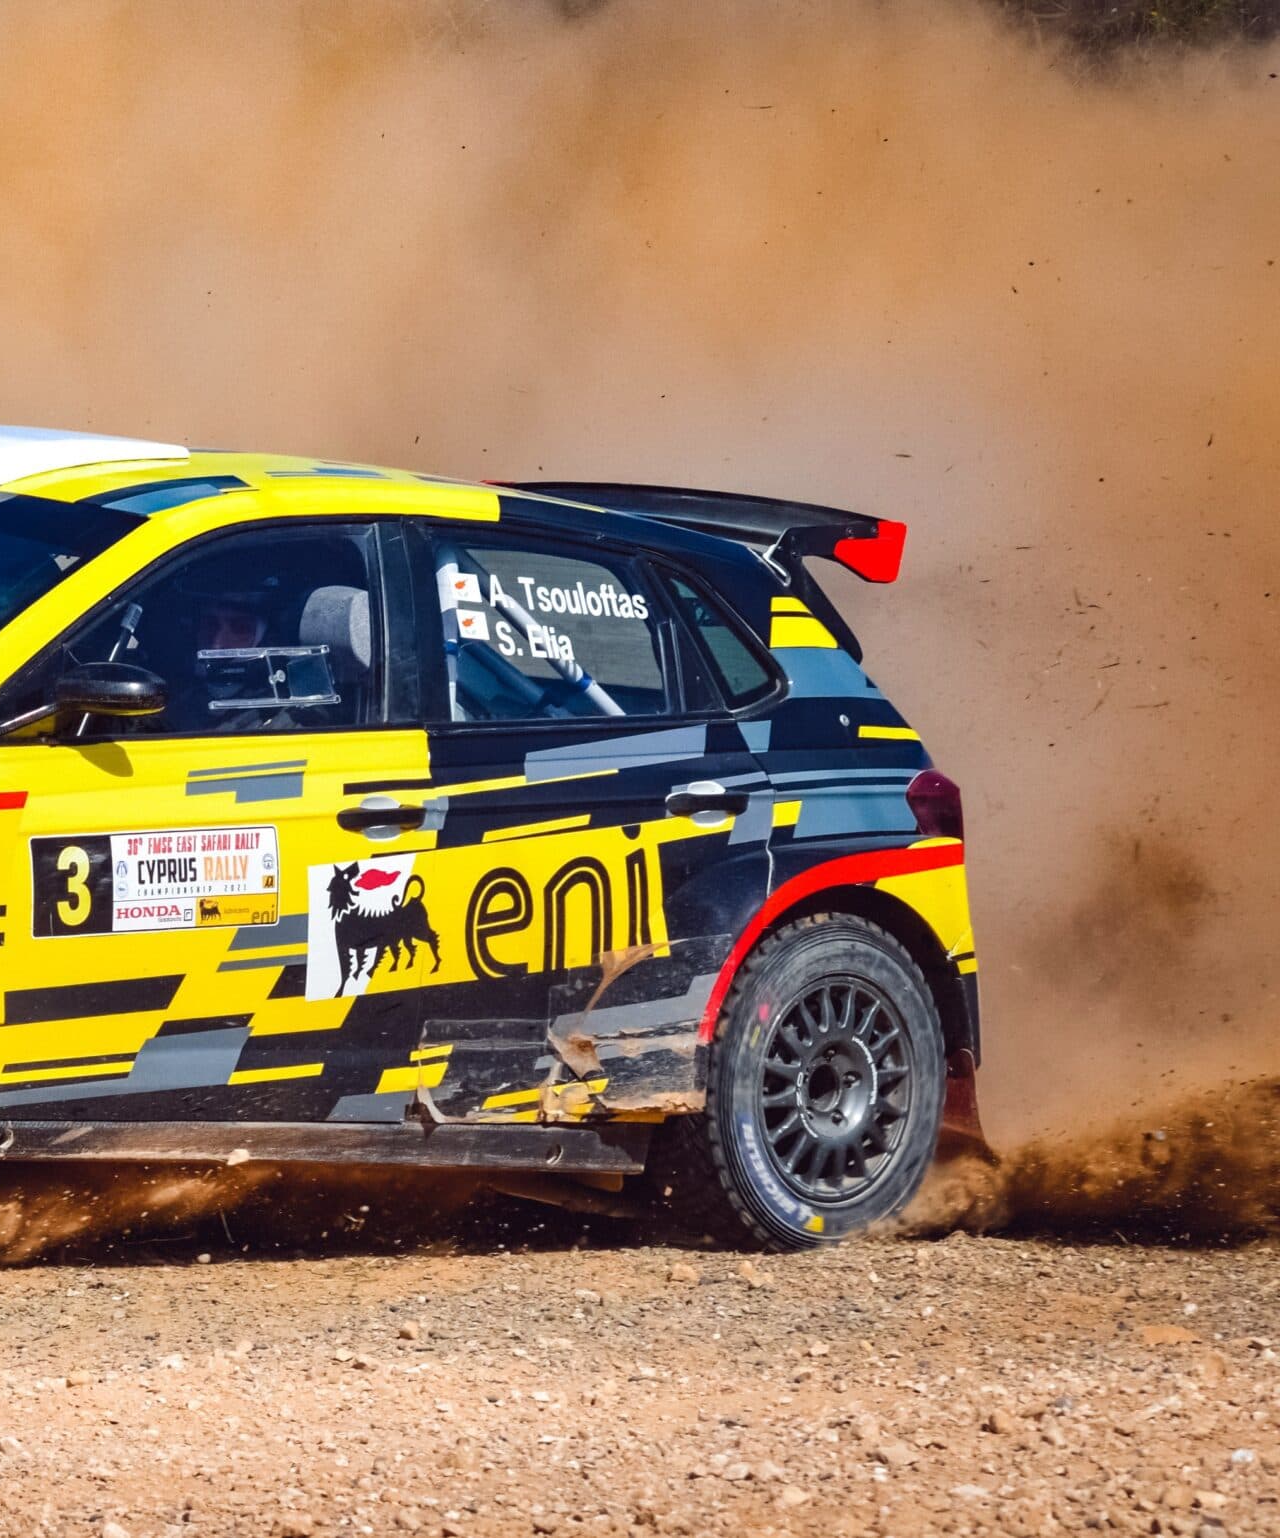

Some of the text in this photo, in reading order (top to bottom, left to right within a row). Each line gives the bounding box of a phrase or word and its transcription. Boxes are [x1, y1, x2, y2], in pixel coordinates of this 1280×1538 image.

[489, 574, 649, 620] A. Tsouloftas
[495, 621, 575, 661] S. Elia
[176, 835, 197, 853] EAST
[201, 833, 231, 852] SAFARI
[234, 832, 260, 850] RALLY
[56, 845, 92, 927] 3
[137, 855, 249, 885] CYPRUS RALLY
[116, 904, 182, 919] HONDA
[251, 904, 275, 924] eni
[465, 825, 652, 979] eni
